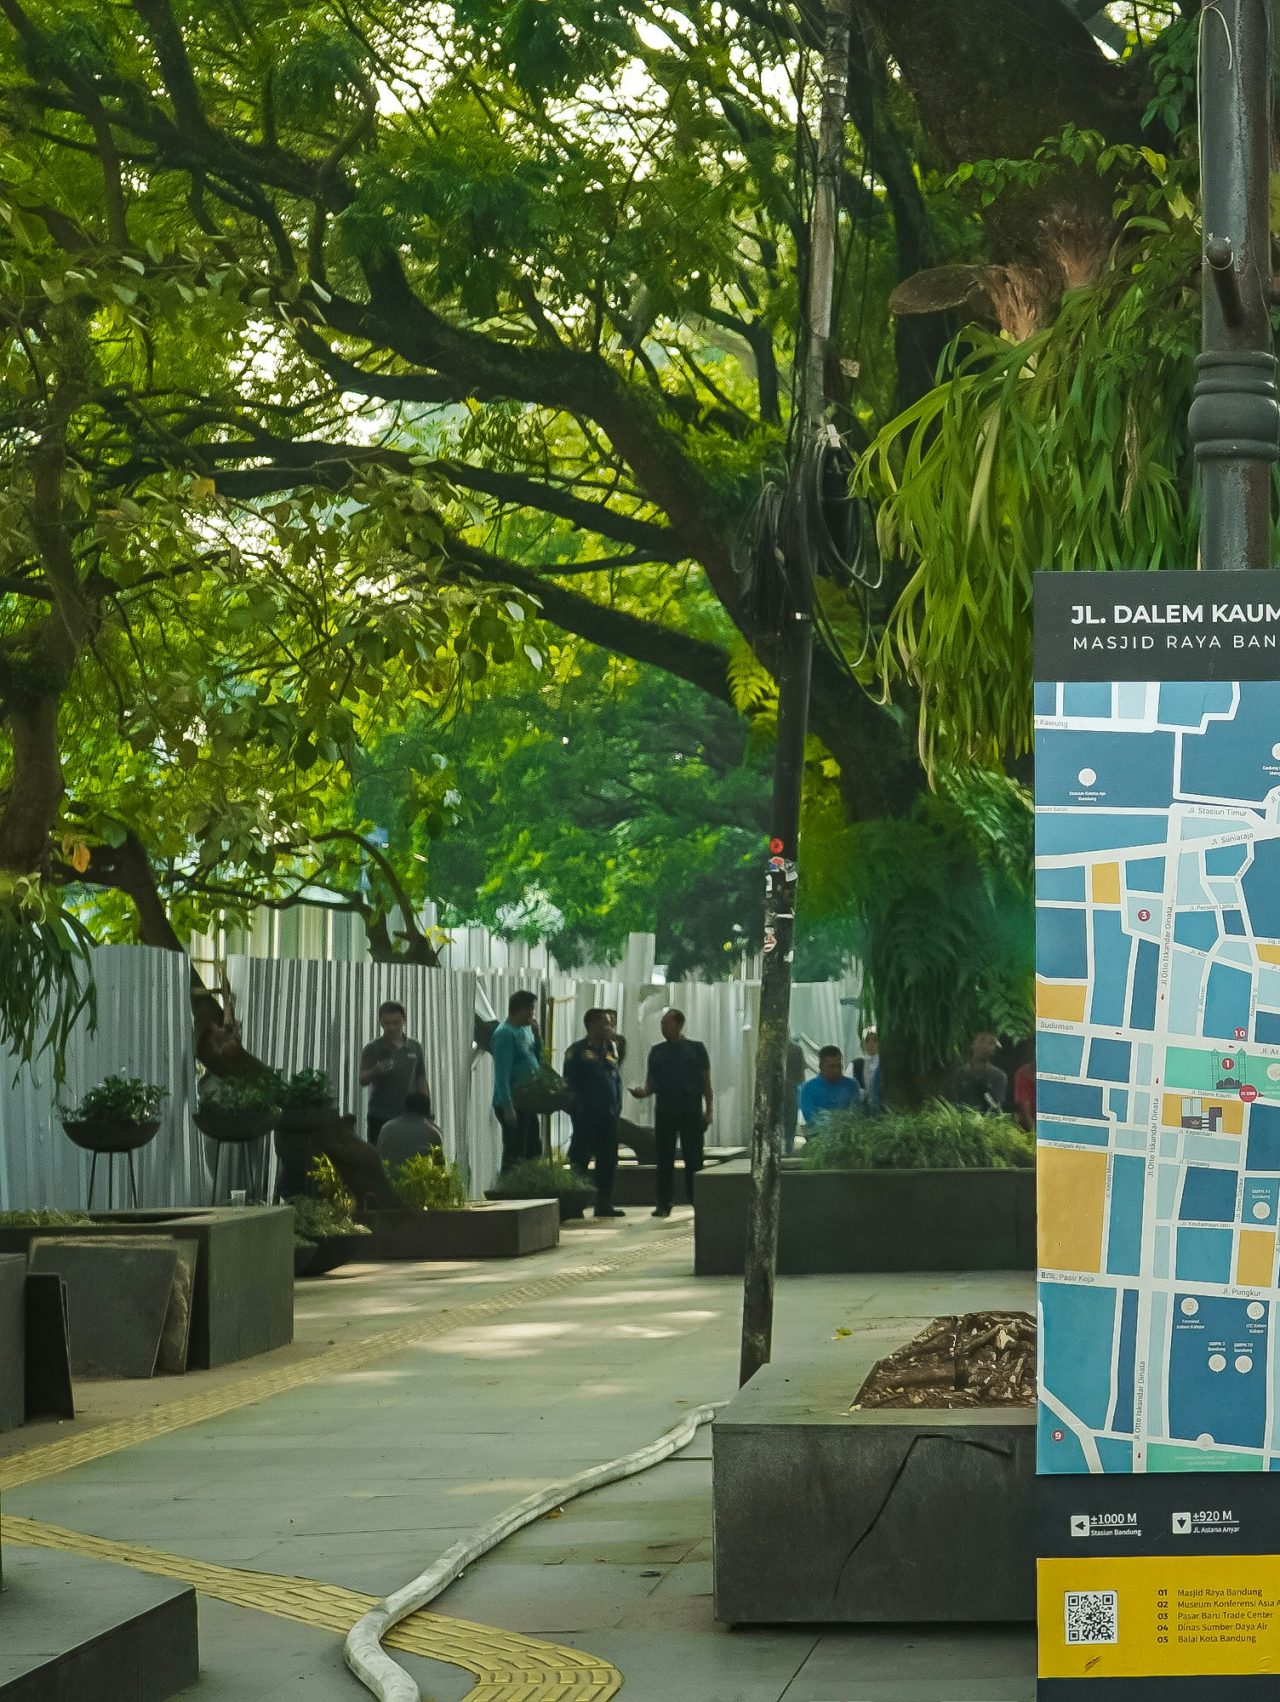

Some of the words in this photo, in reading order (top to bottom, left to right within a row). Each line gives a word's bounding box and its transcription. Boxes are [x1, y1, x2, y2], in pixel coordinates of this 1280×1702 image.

[1071, 605, 1106, 624] JL.
[1114, 604, 1203, 624] DALEM
[1073, 636, 1155, 650] MASJID
[1167, 635, 1221, 649] RAYA
[1040, 718, 1068, 728] Kawung
[1227, 809, 1247, 817] Timur
[1221, 832, 1254, 844] Suniaraja
[1141, 911, 1148, 920] 3
[1165, 907, 1173, 929] Dinata
[1163, 930, 1171, 962] Iskandar
[1040, 1021, 1074, 1031] Sudirman
[1151, 1097, 1159, 1122] Dinata
[1149, 1122, 1158, 1155] Iskandar
[1148, 1155, 1156, 1171] Otto
[1059, 1274, 1077, 1282] Pasir
[1078, 1275, 1095, 1283] Koja
[1232, 1288, 1262, 1297] Pungkur
[1136, 1385, 1144, 1419] Iskandar
[1056, 1432, 1062, 1440] 9
[1091, 1514, 1124, 1525] ±1000
[1127, 1513, 1137, 1523] M
[1193, 1511, 1220, 1522] ±920
[1223, 1510, 1232, 1521] M
[1114, 1528, 1142, 1537] Bandung
[1222, 1526, 1240, 1534] Anyar
[1177, 1589, 1203, 1599] Masjid
[1205, 1589, 1225, 1598] Raya
[1226, 1588, 1263, 1597] Bandung
[1213, 1600, 1257, 1608] Konferensi
[1177, 1612, 1200, 1620] Pasar
[1222, 1611, 1245, 1619] Trade
[1247, 1611, 1274, 1619] Center
[1157, 1624, 1168, 1632] 04
[1201, 1623, 1233, 1631] Sumber
[1235, 1623, 1255, 1631] Daya
[1256, 1622, 1268, 1630] Air
[1177, 1635, 1198, 1643] Balai
[1200, 1635, 1218, 1643] Kota
[1220, 1634, 1257, 1643] Bandung
